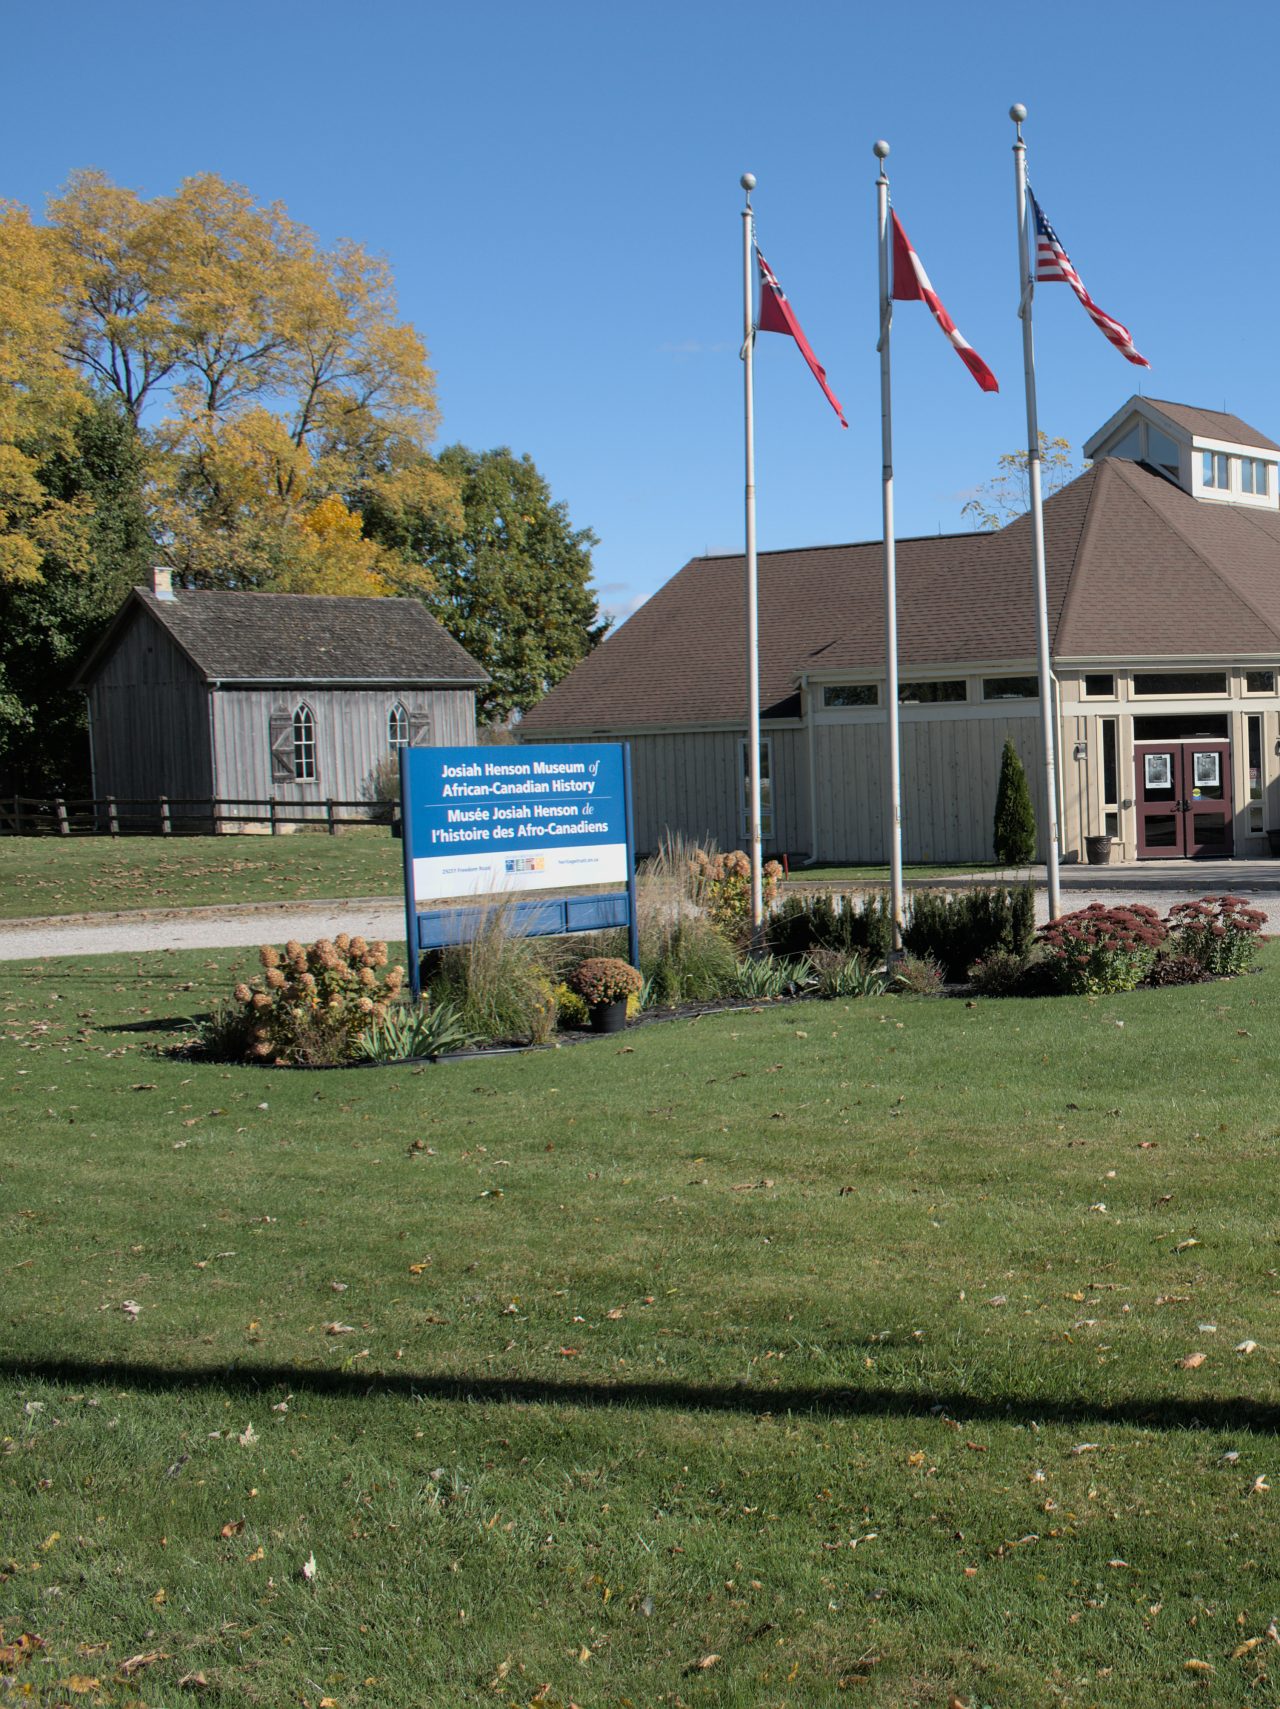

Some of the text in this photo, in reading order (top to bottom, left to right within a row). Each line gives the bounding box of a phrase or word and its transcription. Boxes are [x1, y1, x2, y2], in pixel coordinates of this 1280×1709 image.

[441, 760, 600, 778] Josiah Henson Museum of
[442, 779, 595, 797] African-Canadian History
[447, 802, 595, 823] Musée Josiah Henson de
[492, 825, 514, 839] des
[517, 821, 609, 837] Afro-Canadiens
